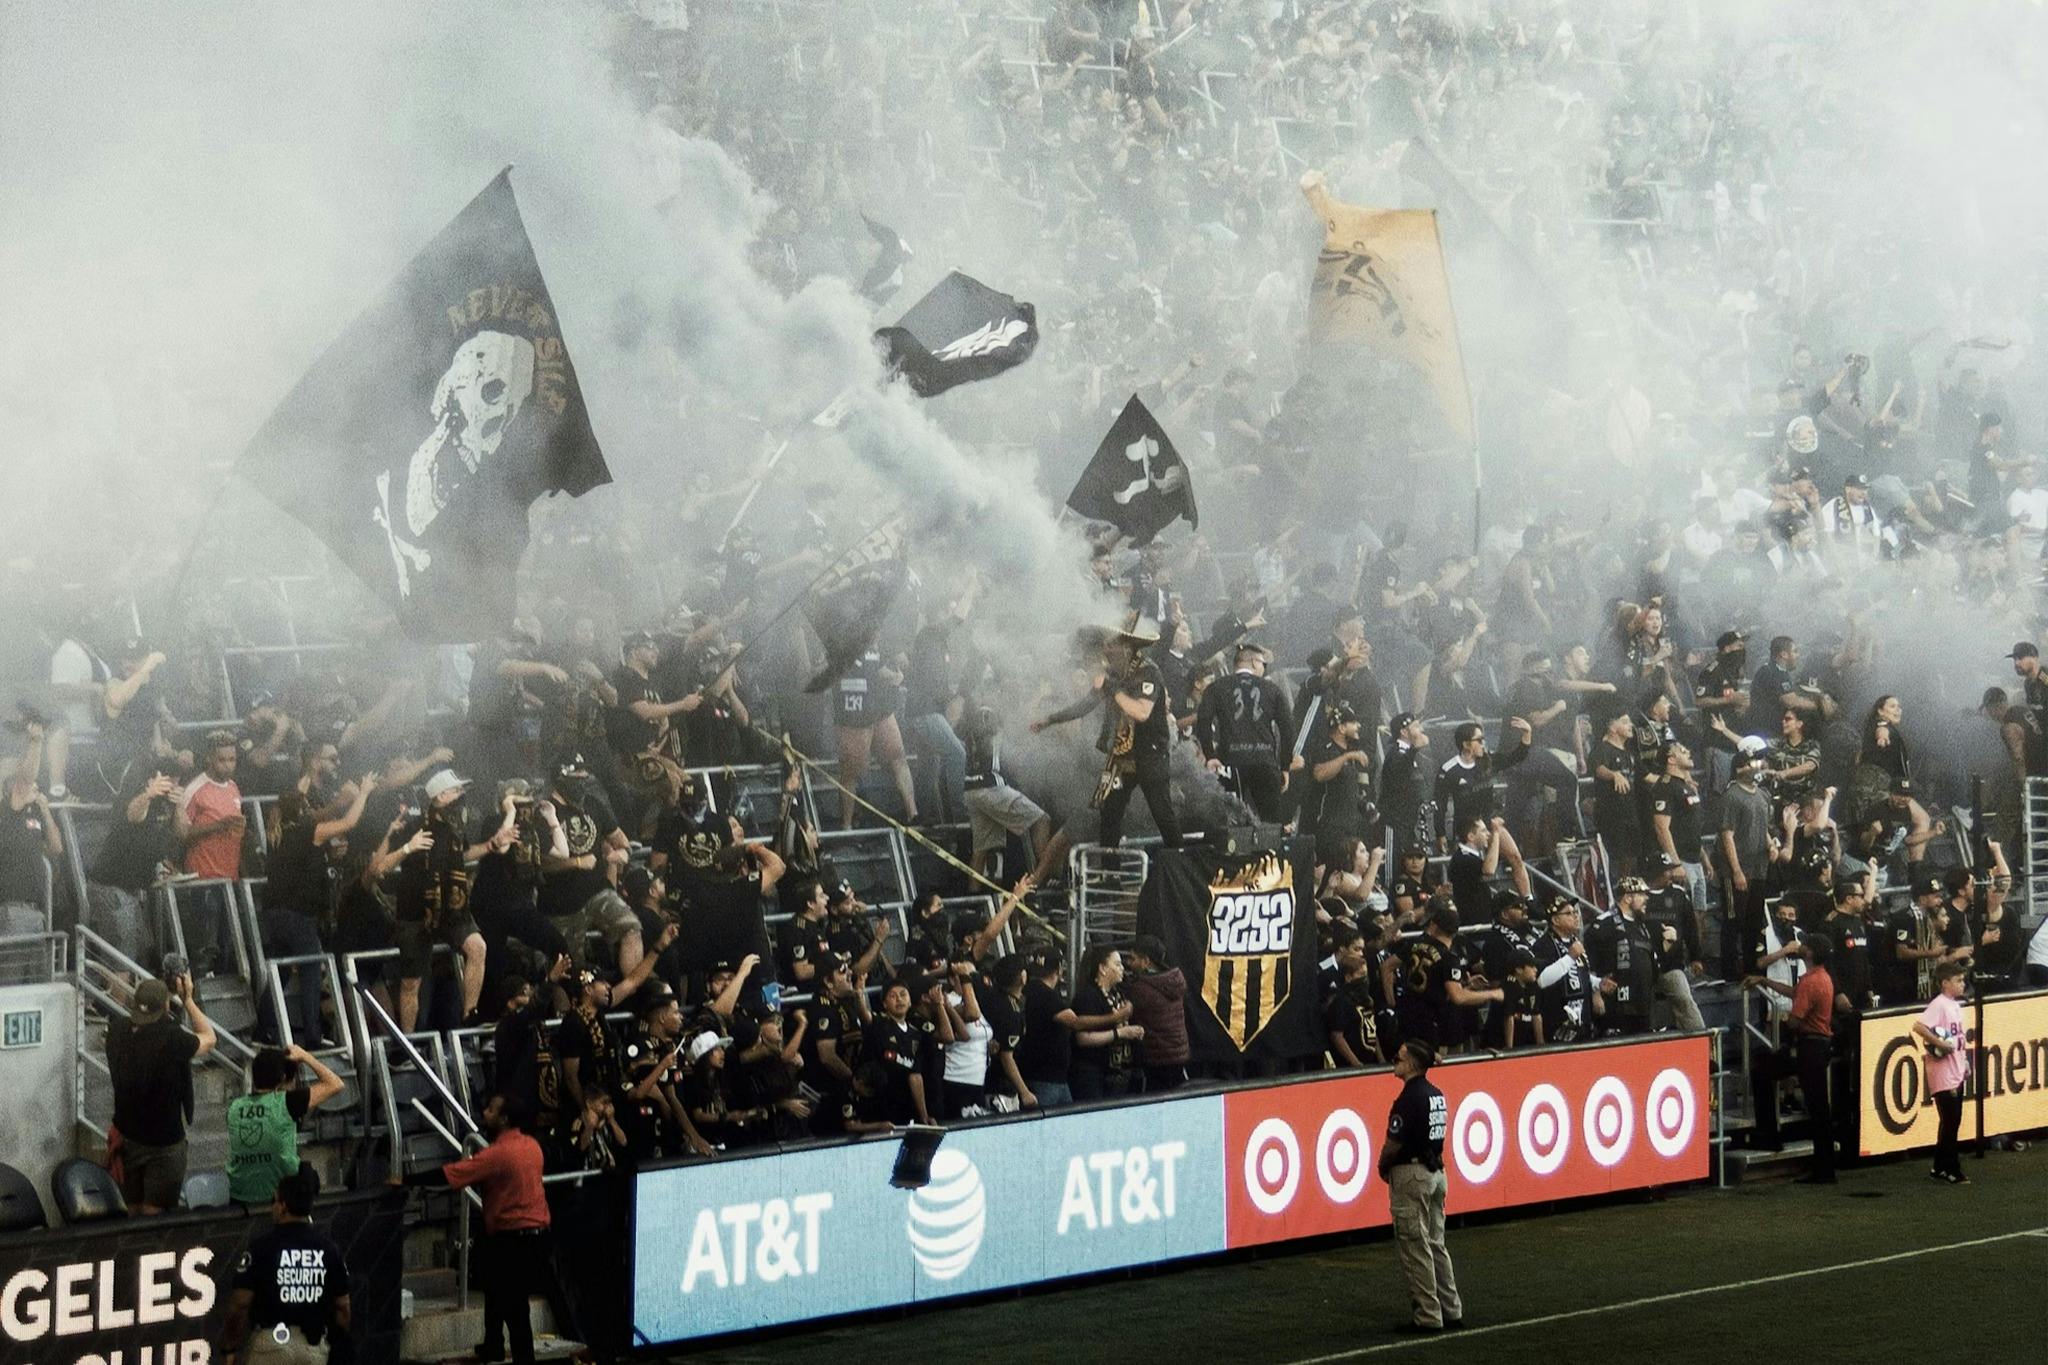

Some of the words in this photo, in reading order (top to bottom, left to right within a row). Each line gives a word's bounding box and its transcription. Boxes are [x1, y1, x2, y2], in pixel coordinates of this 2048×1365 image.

[1211, 893, 1292, 953] 3252
[9, 1013, 38, 1044] EXIT
[235, 1153, 272, 1165] PHOTO
[1056, 1141, 1186, 1235] AT&T
[280, 1250, 325, 1267] APEX
[681, 1192, 833, 1294] AT&T
[277, 1268, 327, 1285] SECURITY
[0, 1247, 216, 1341] GELES
[280, 1286, 323, 1303] GROUP
